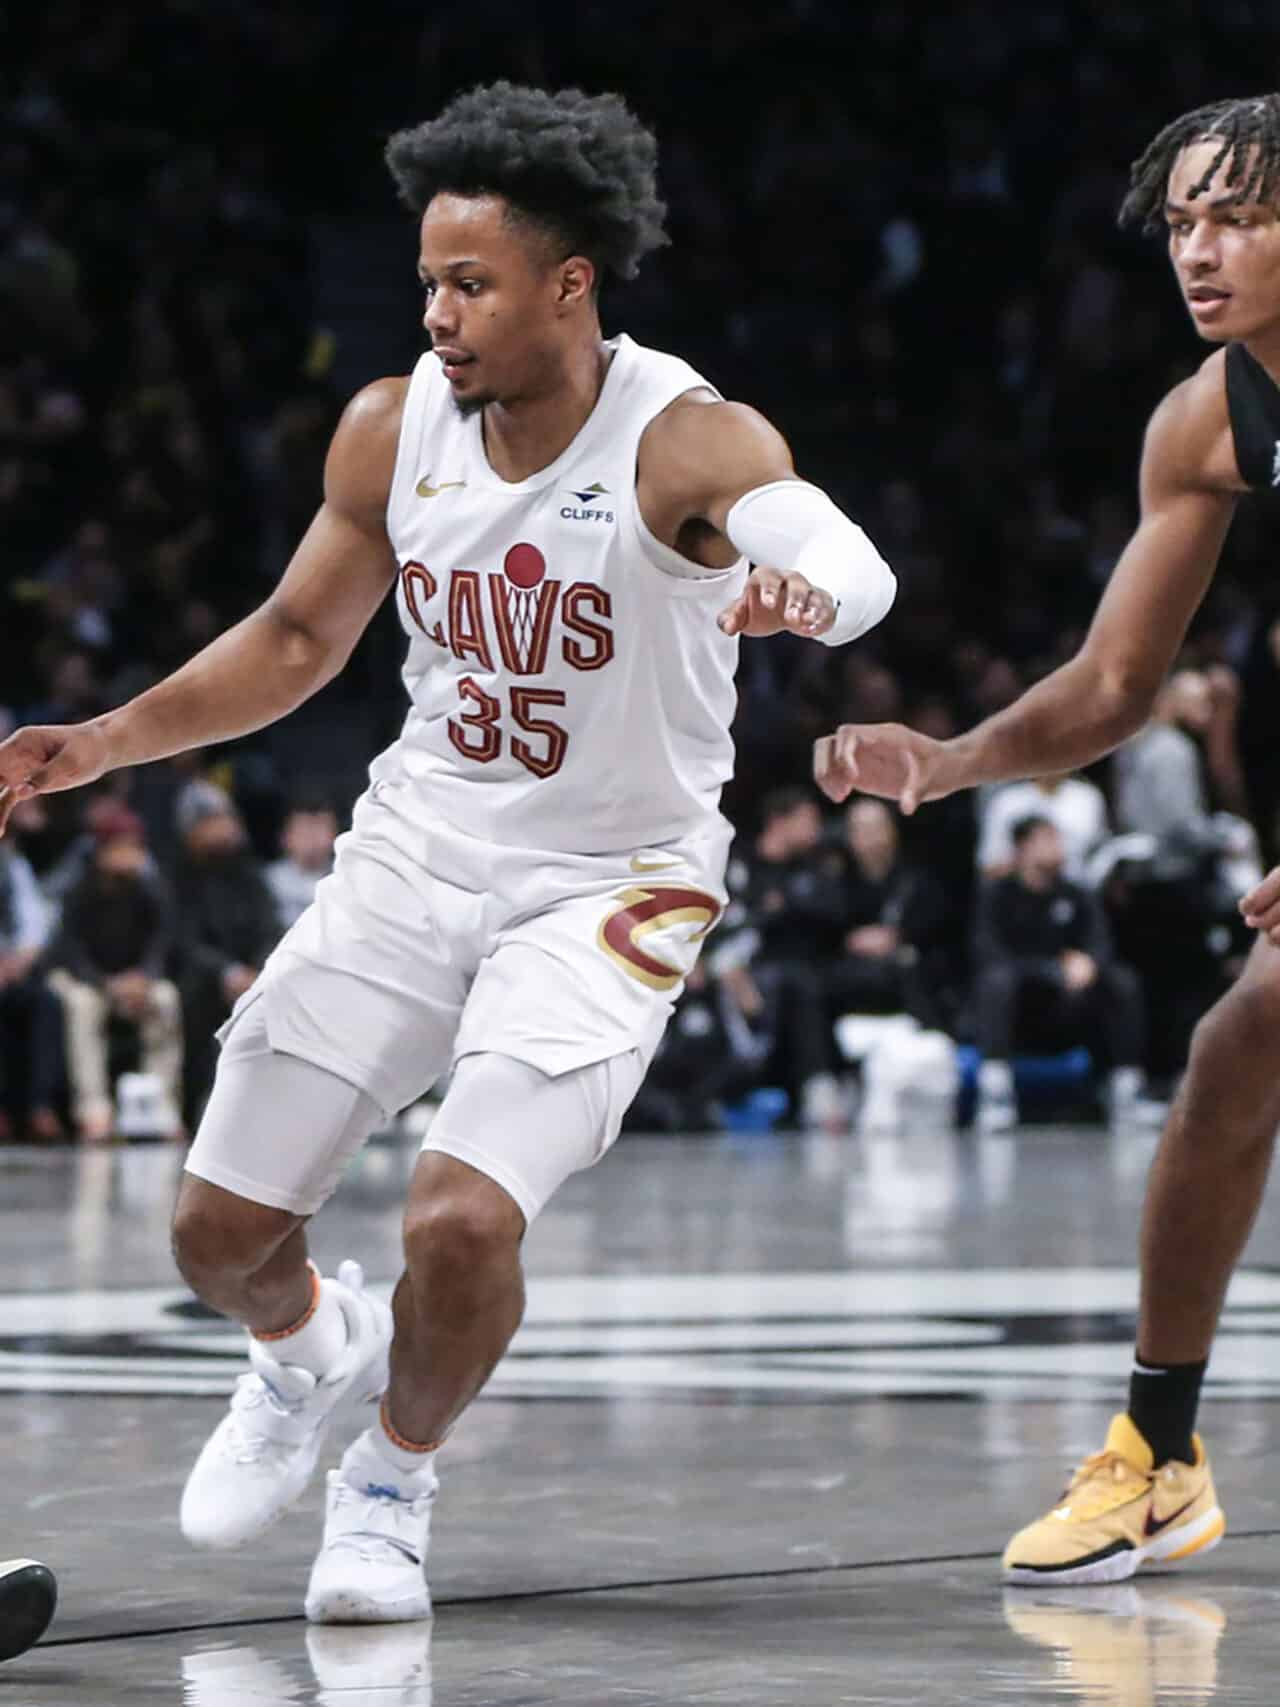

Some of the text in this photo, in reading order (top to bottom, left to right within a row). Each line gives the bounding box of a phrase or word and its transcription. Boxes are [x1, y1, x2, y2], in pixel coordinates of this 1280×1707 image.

[559, 507, 615, 523] CLIFFS
[401, 559, 615, 675] CAVS
[447, 675, 569, 780] 35
